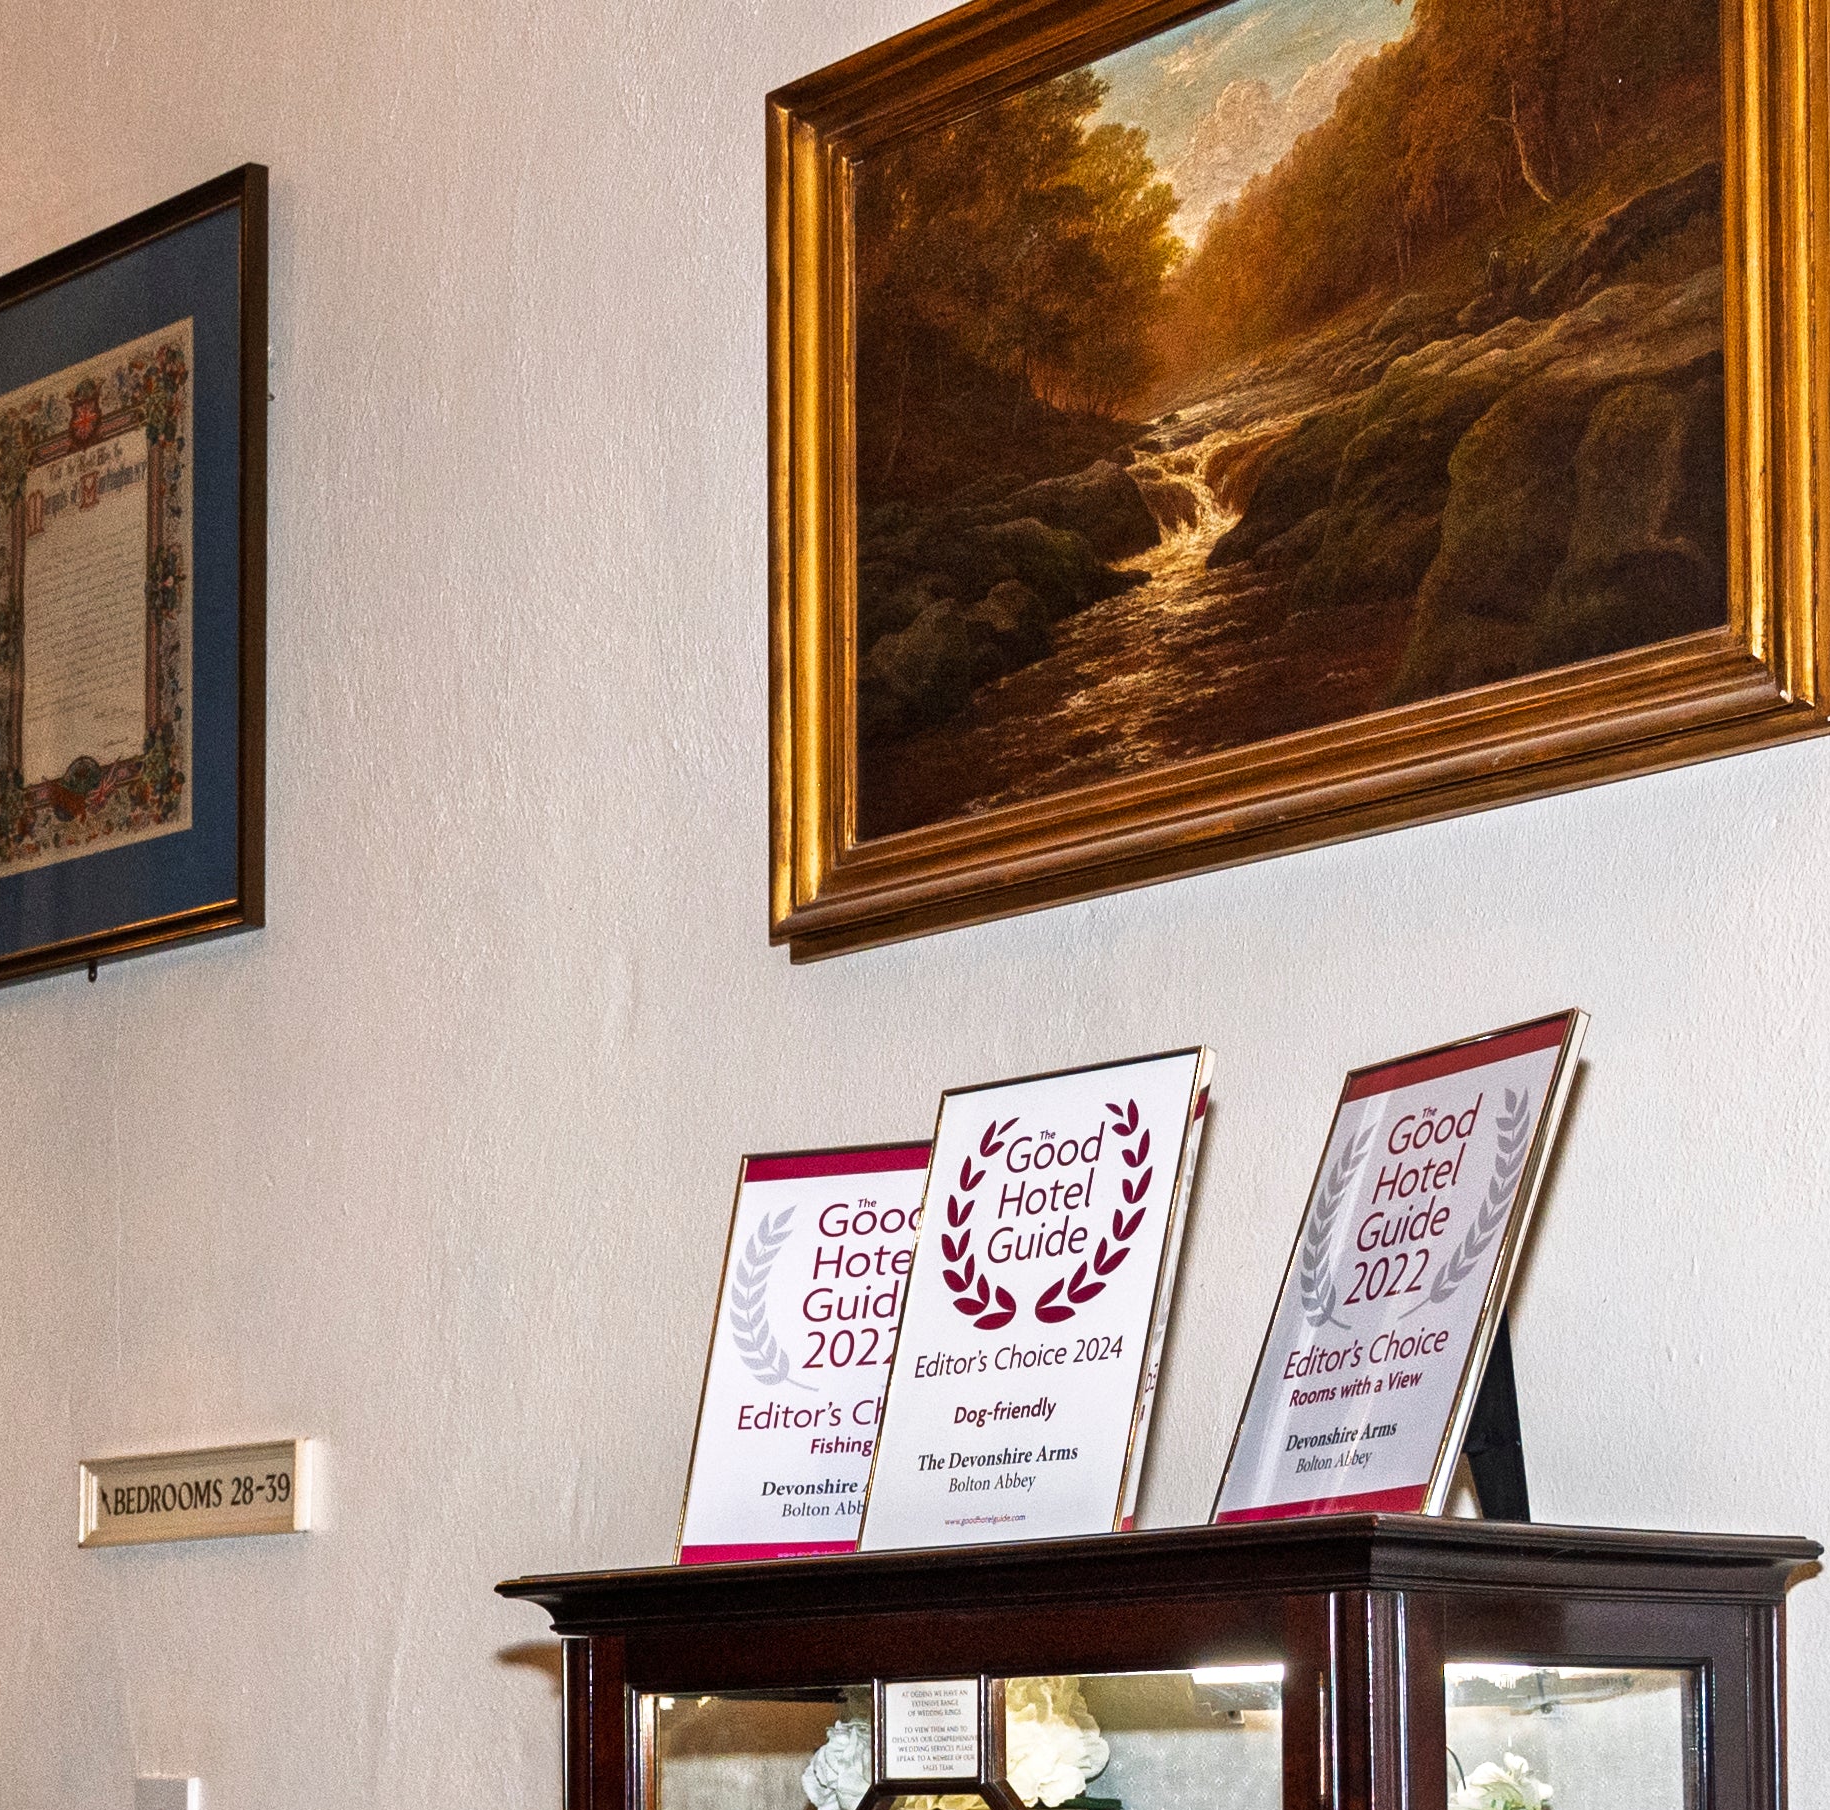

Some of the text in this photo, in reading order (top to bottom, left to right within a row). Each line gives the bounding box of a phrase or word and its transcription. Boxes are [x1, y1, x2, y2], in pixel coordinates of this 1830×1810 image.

[1387, 1092, 1484, 1155] Good
[1422, 1106, 1438, 1118] The
[1005, 1121, 1105, 1174] Good
[1040, 1130, 1056, 1140] The
[1371, 1142, 1467, 1206] Hotel
[858, 1198, 877, 1208] The
[997, 1168, 1095, 1219] Hotel
[988, 1215, 1088, 1264] Guide
[1356, 1196, 1451, 1254] Guide
[1342, 1248, 1431, 1307] 2022
[914, 1335, 1124, 1379] Editor’s Choice 2024
[1282, 1327, 1450, 1381] Editor’s Choice
[1289, 1369, 1423, 1409] Rooms with a View
[738, 1401, 842, 1430] Editor’s
[953, 1396, 1057, 1428] Dog-friendly
[810, 1436, 874, 1458] Fishing
[1285, 1419, 1399, 1452] Devonshire Arms
[918, 1445, 1079, 1472] The Devonshire Arms
[1295, 1448, 1373, 1474] Bolton Abbey
[113, 1473, 291, 1516] BEDROOMS 28-39
[762, 1479, 859, 1497] Devonshire
[948, 1472, 1037, 1494] Bolton Abbey
[782, 1502, 831, 1517] Bolton
[944, 1513, 1026, 1527] www.goodhotelguide.com
